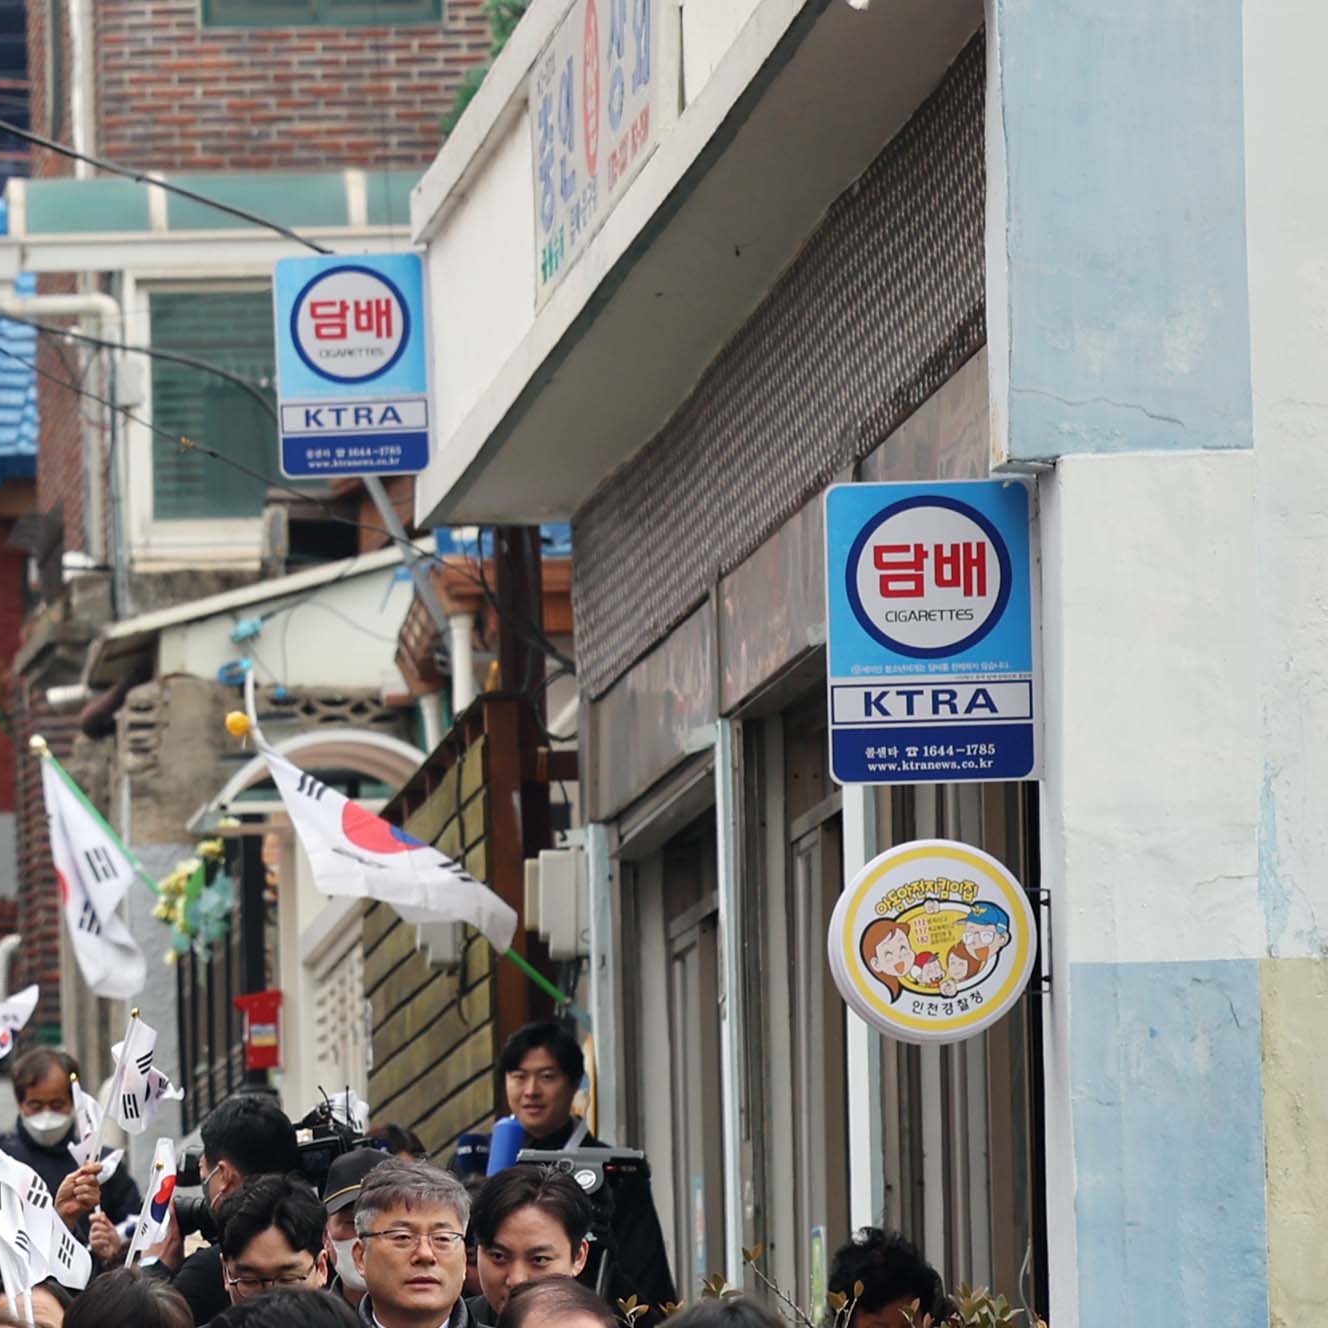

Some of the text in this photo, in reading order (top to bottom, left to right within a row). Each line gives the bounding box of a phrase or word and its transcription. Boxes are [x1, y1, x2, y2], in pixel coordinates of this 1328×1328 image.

[309, 297, 394, 341] 담배
[304, 405, 403, 428] KTRA
[872, 541, 987, 599] 담배
[884, 608, 975, 623] CIGARETTES
[863, 687, 999, 717] KTRA
[923, 743, 996, 757] 1644-1785
[867, 757, 994, 772] www.ktranews.co.kr
[874, 876, 979, 916] 아동안전지킴이집
[911, 990, 984, 1017] 인천경찰청
